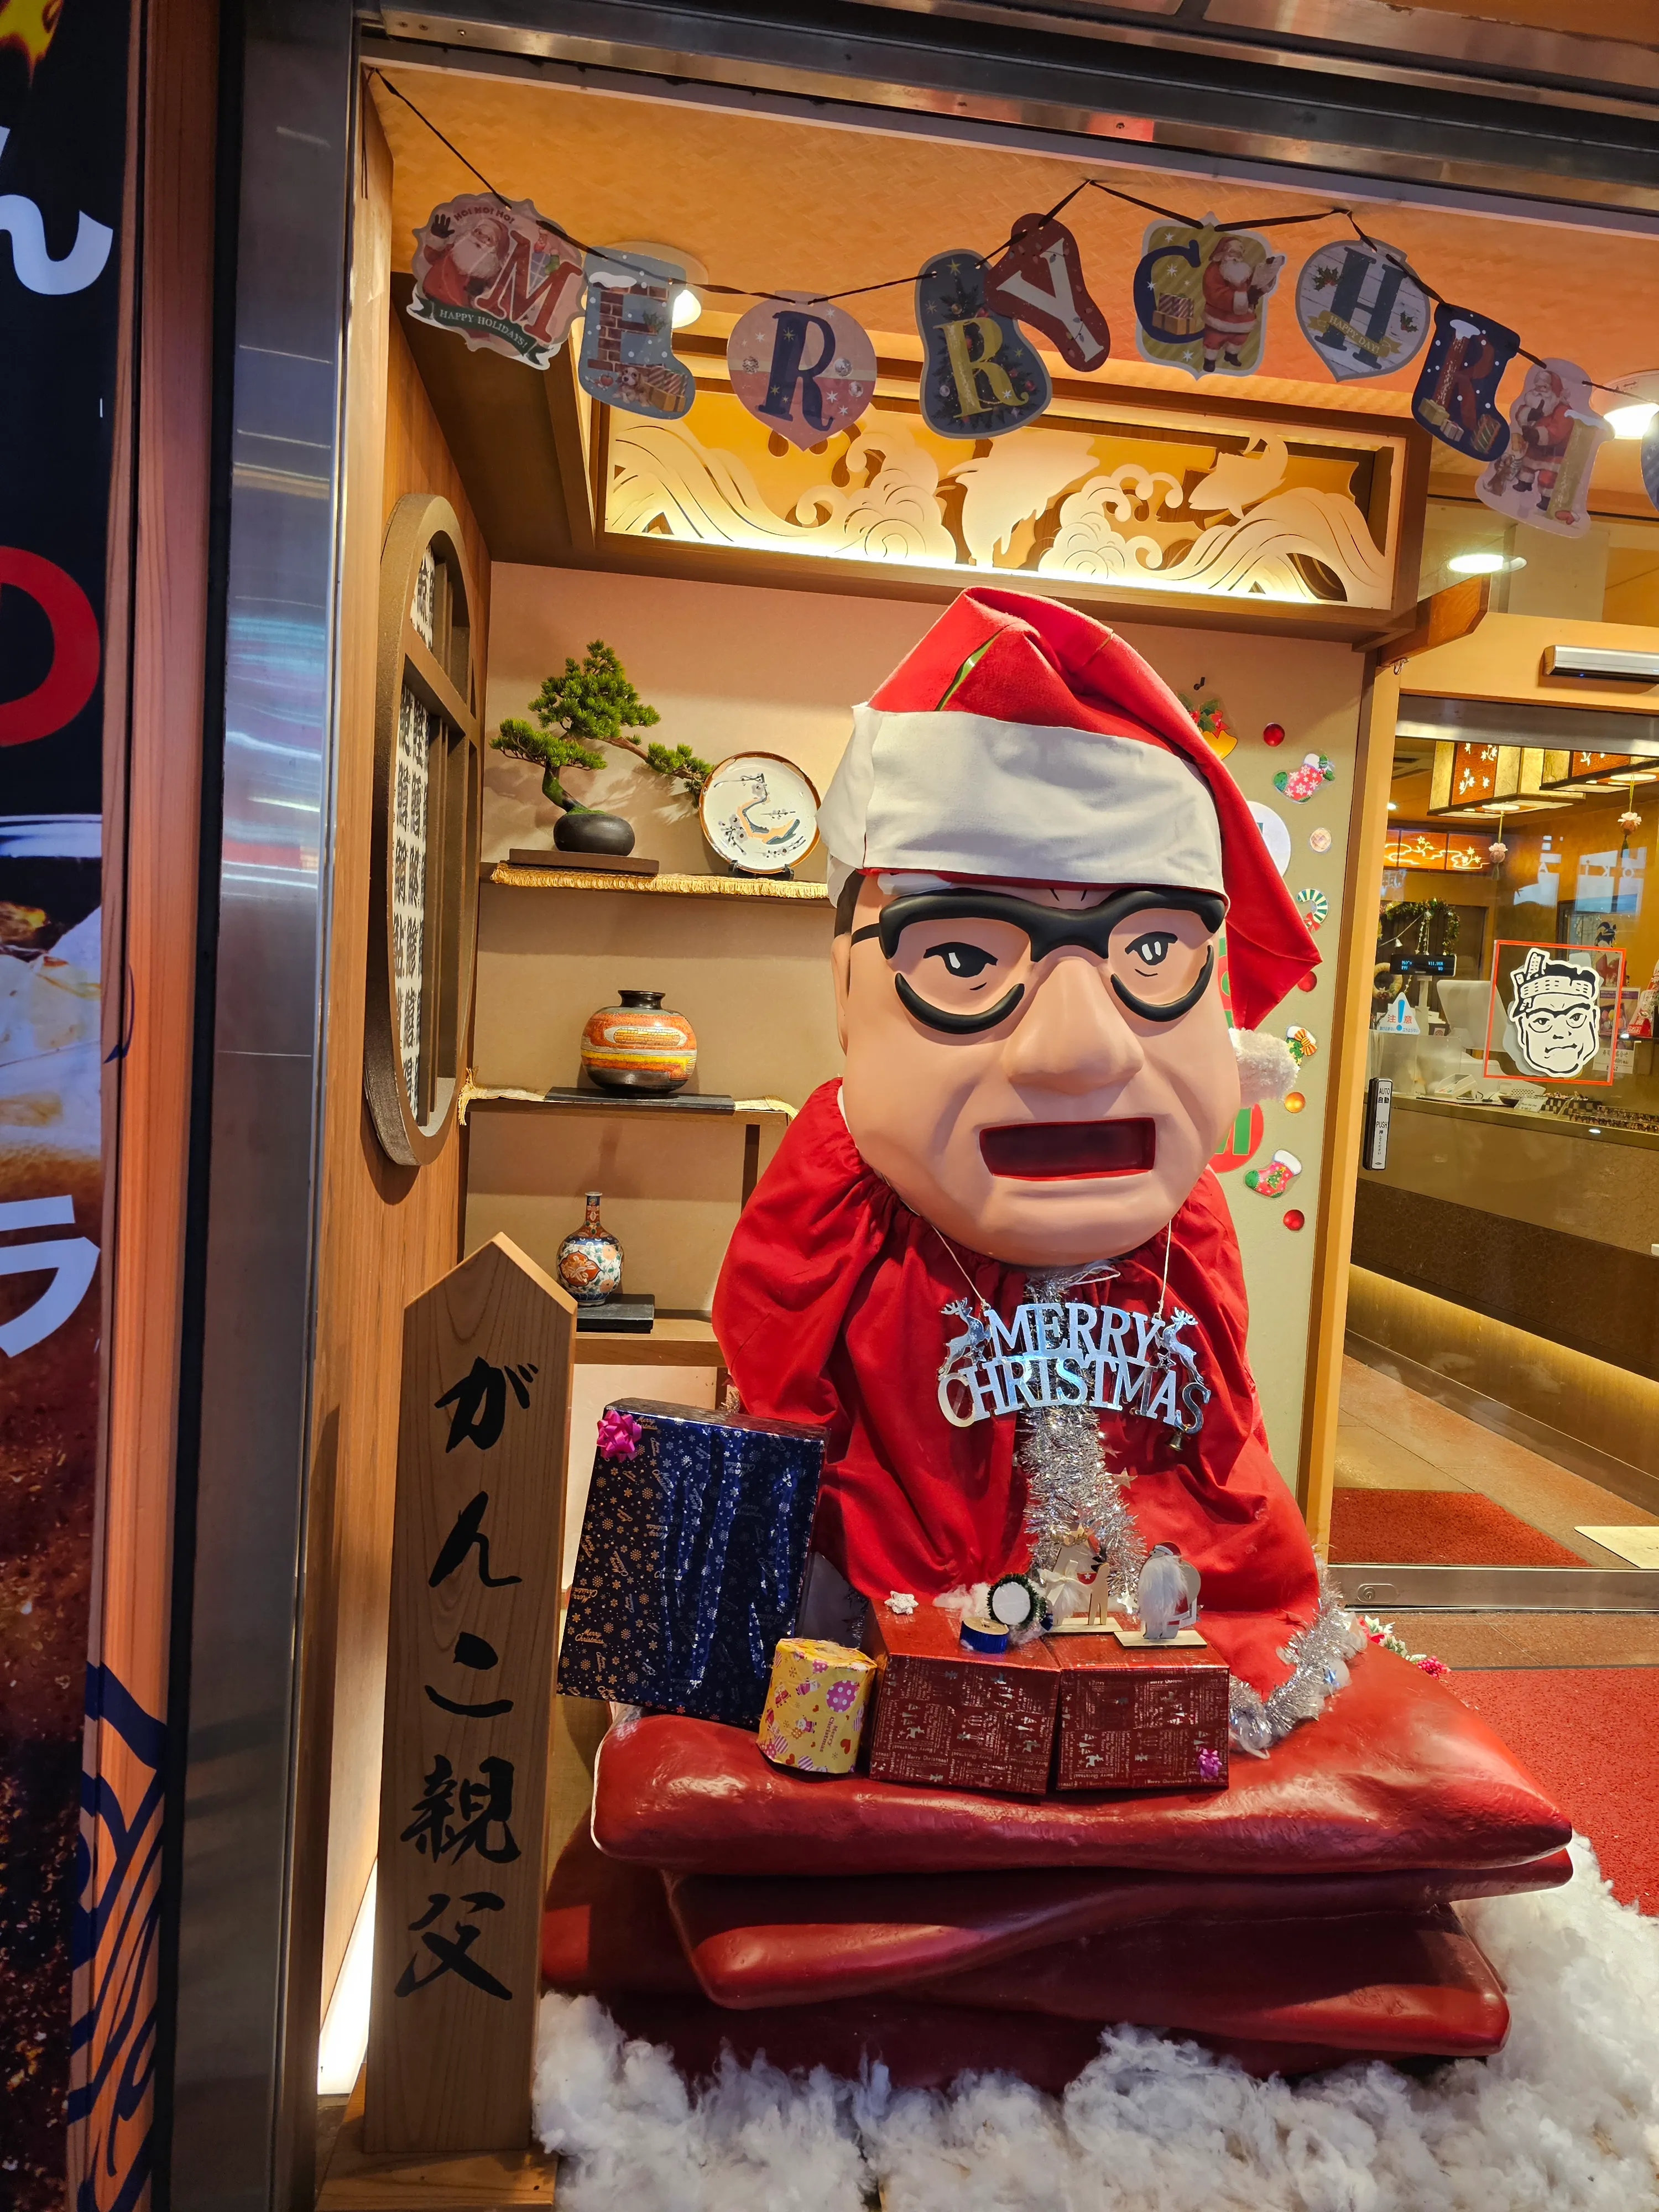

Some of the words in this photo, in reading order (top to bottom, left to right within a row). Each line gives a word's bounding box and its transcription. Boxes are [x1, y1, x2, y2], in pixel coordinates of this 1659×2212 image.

[453, 208, 473, 221] HO!
[474, 206, 494, 215] HO!
[495, 210, 515, 224] HO!
[440, 309, 474, 322] HAPPY
[477, 316, 528, 348] HOLIDAYS!
[1329, 315, 1357, 338] HAPPY
[1359, 336, 1381, 354] DAY!
[983, 1302, 1165, 1368] MERRY
[937, 1355, 1211, 1435] CHRISTMAS
[575, 1634, 604, 1645] Christmas
[582, 1628, 602, 1638] Merry
[395, 1355, 539, 2002] がんこ親父
[820, 1716, 834, 1752] Christmas
[827, 1725, 838, 1747] Merry
[923, 1755, 949, 1764] Christmas!
